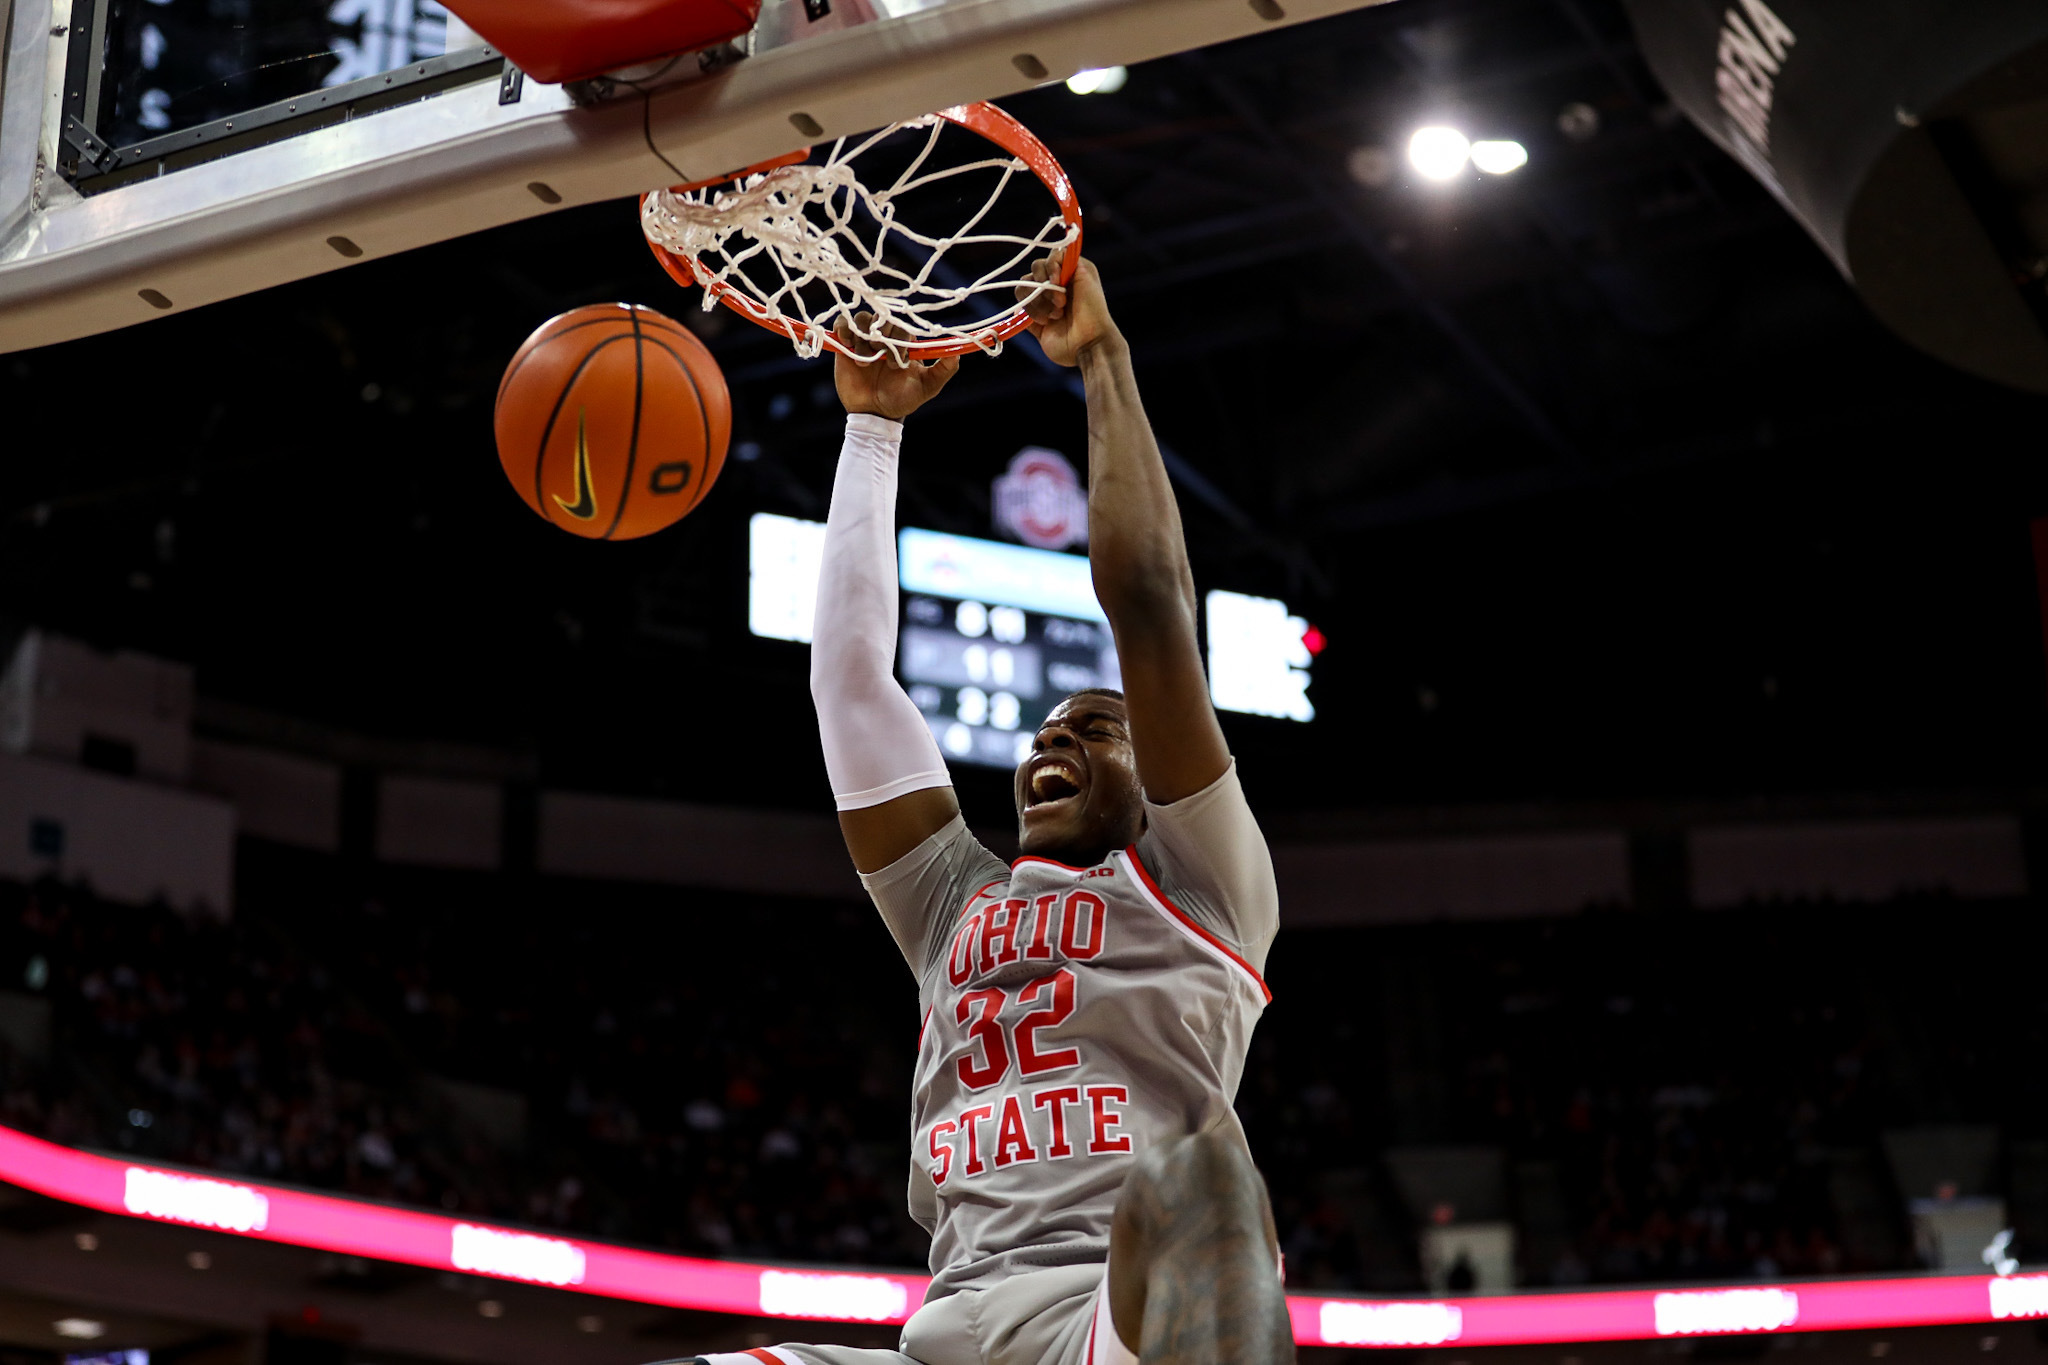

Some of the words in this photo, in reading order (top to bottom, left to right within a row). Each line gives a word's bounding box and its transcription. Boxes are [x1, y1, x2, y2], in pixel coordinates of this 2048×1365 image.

[947, 889, 1108, 989] OHIO
[954, 967, 1082, 1092] 32
[928, 1083, 1134, 1188] STATE
